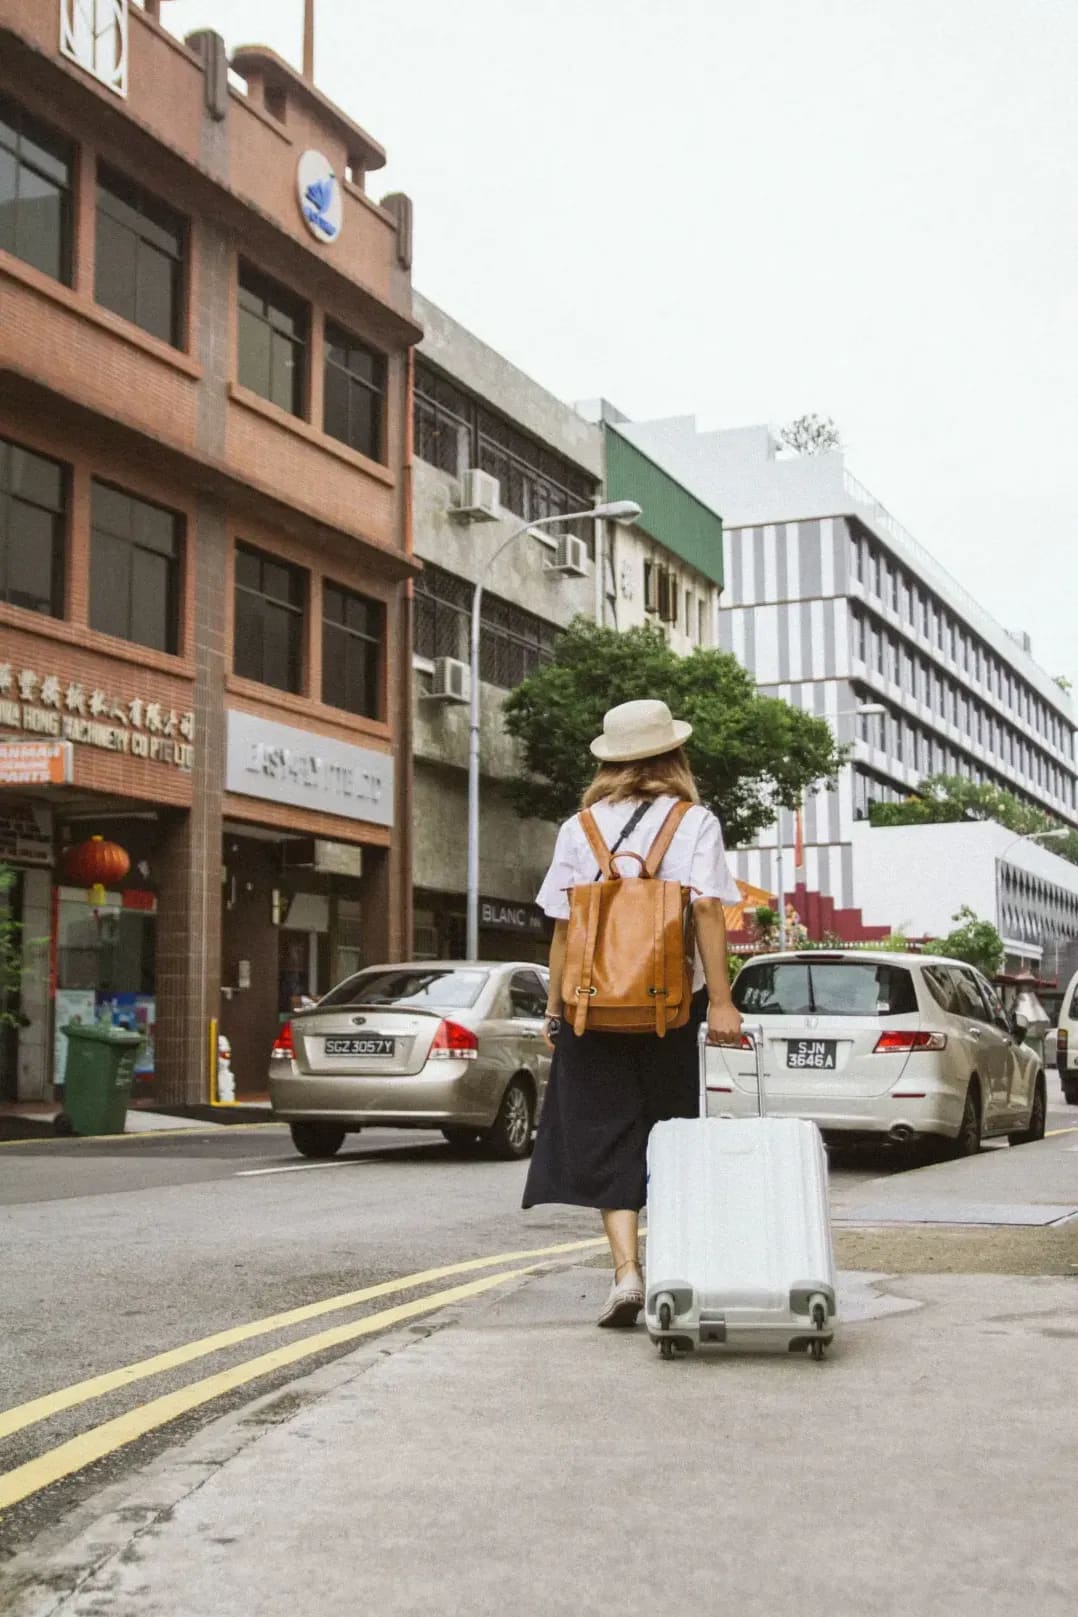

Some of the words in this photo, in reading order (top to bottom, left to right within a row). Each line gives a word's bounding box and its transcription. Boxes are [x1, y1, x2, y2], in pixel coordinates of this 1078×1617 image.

[24, 705, 62, 736] HONG
[132, 732, 149, 759] CO
[151, 737, 175, 765] PTE
[482, 903, 525, 927] BLANC
[799, 1043, 825, 1054] SJN
[789, 1054, 834, 1067] 3646A
